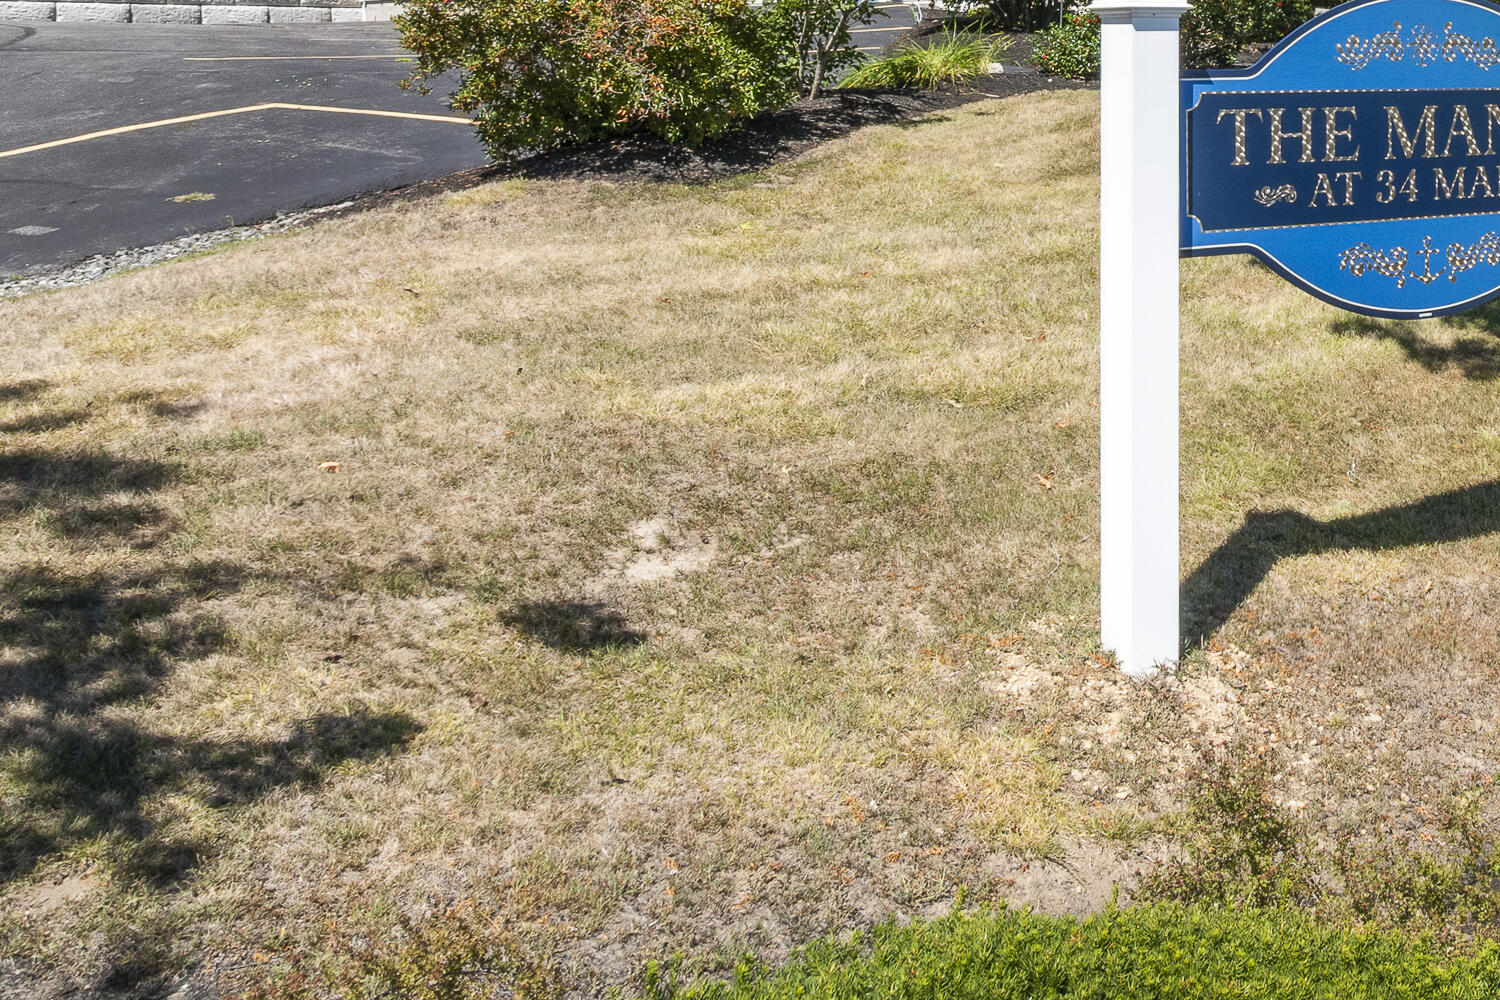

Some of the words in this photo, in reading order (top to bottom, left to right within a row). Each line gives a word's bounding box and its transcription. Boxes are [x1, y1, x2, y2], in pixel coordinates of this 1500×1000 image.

[1217, 105, 1360, 166] THE
[1308, 171, 1363, 208] AT
[1376, 168, 1418, 205] 34
